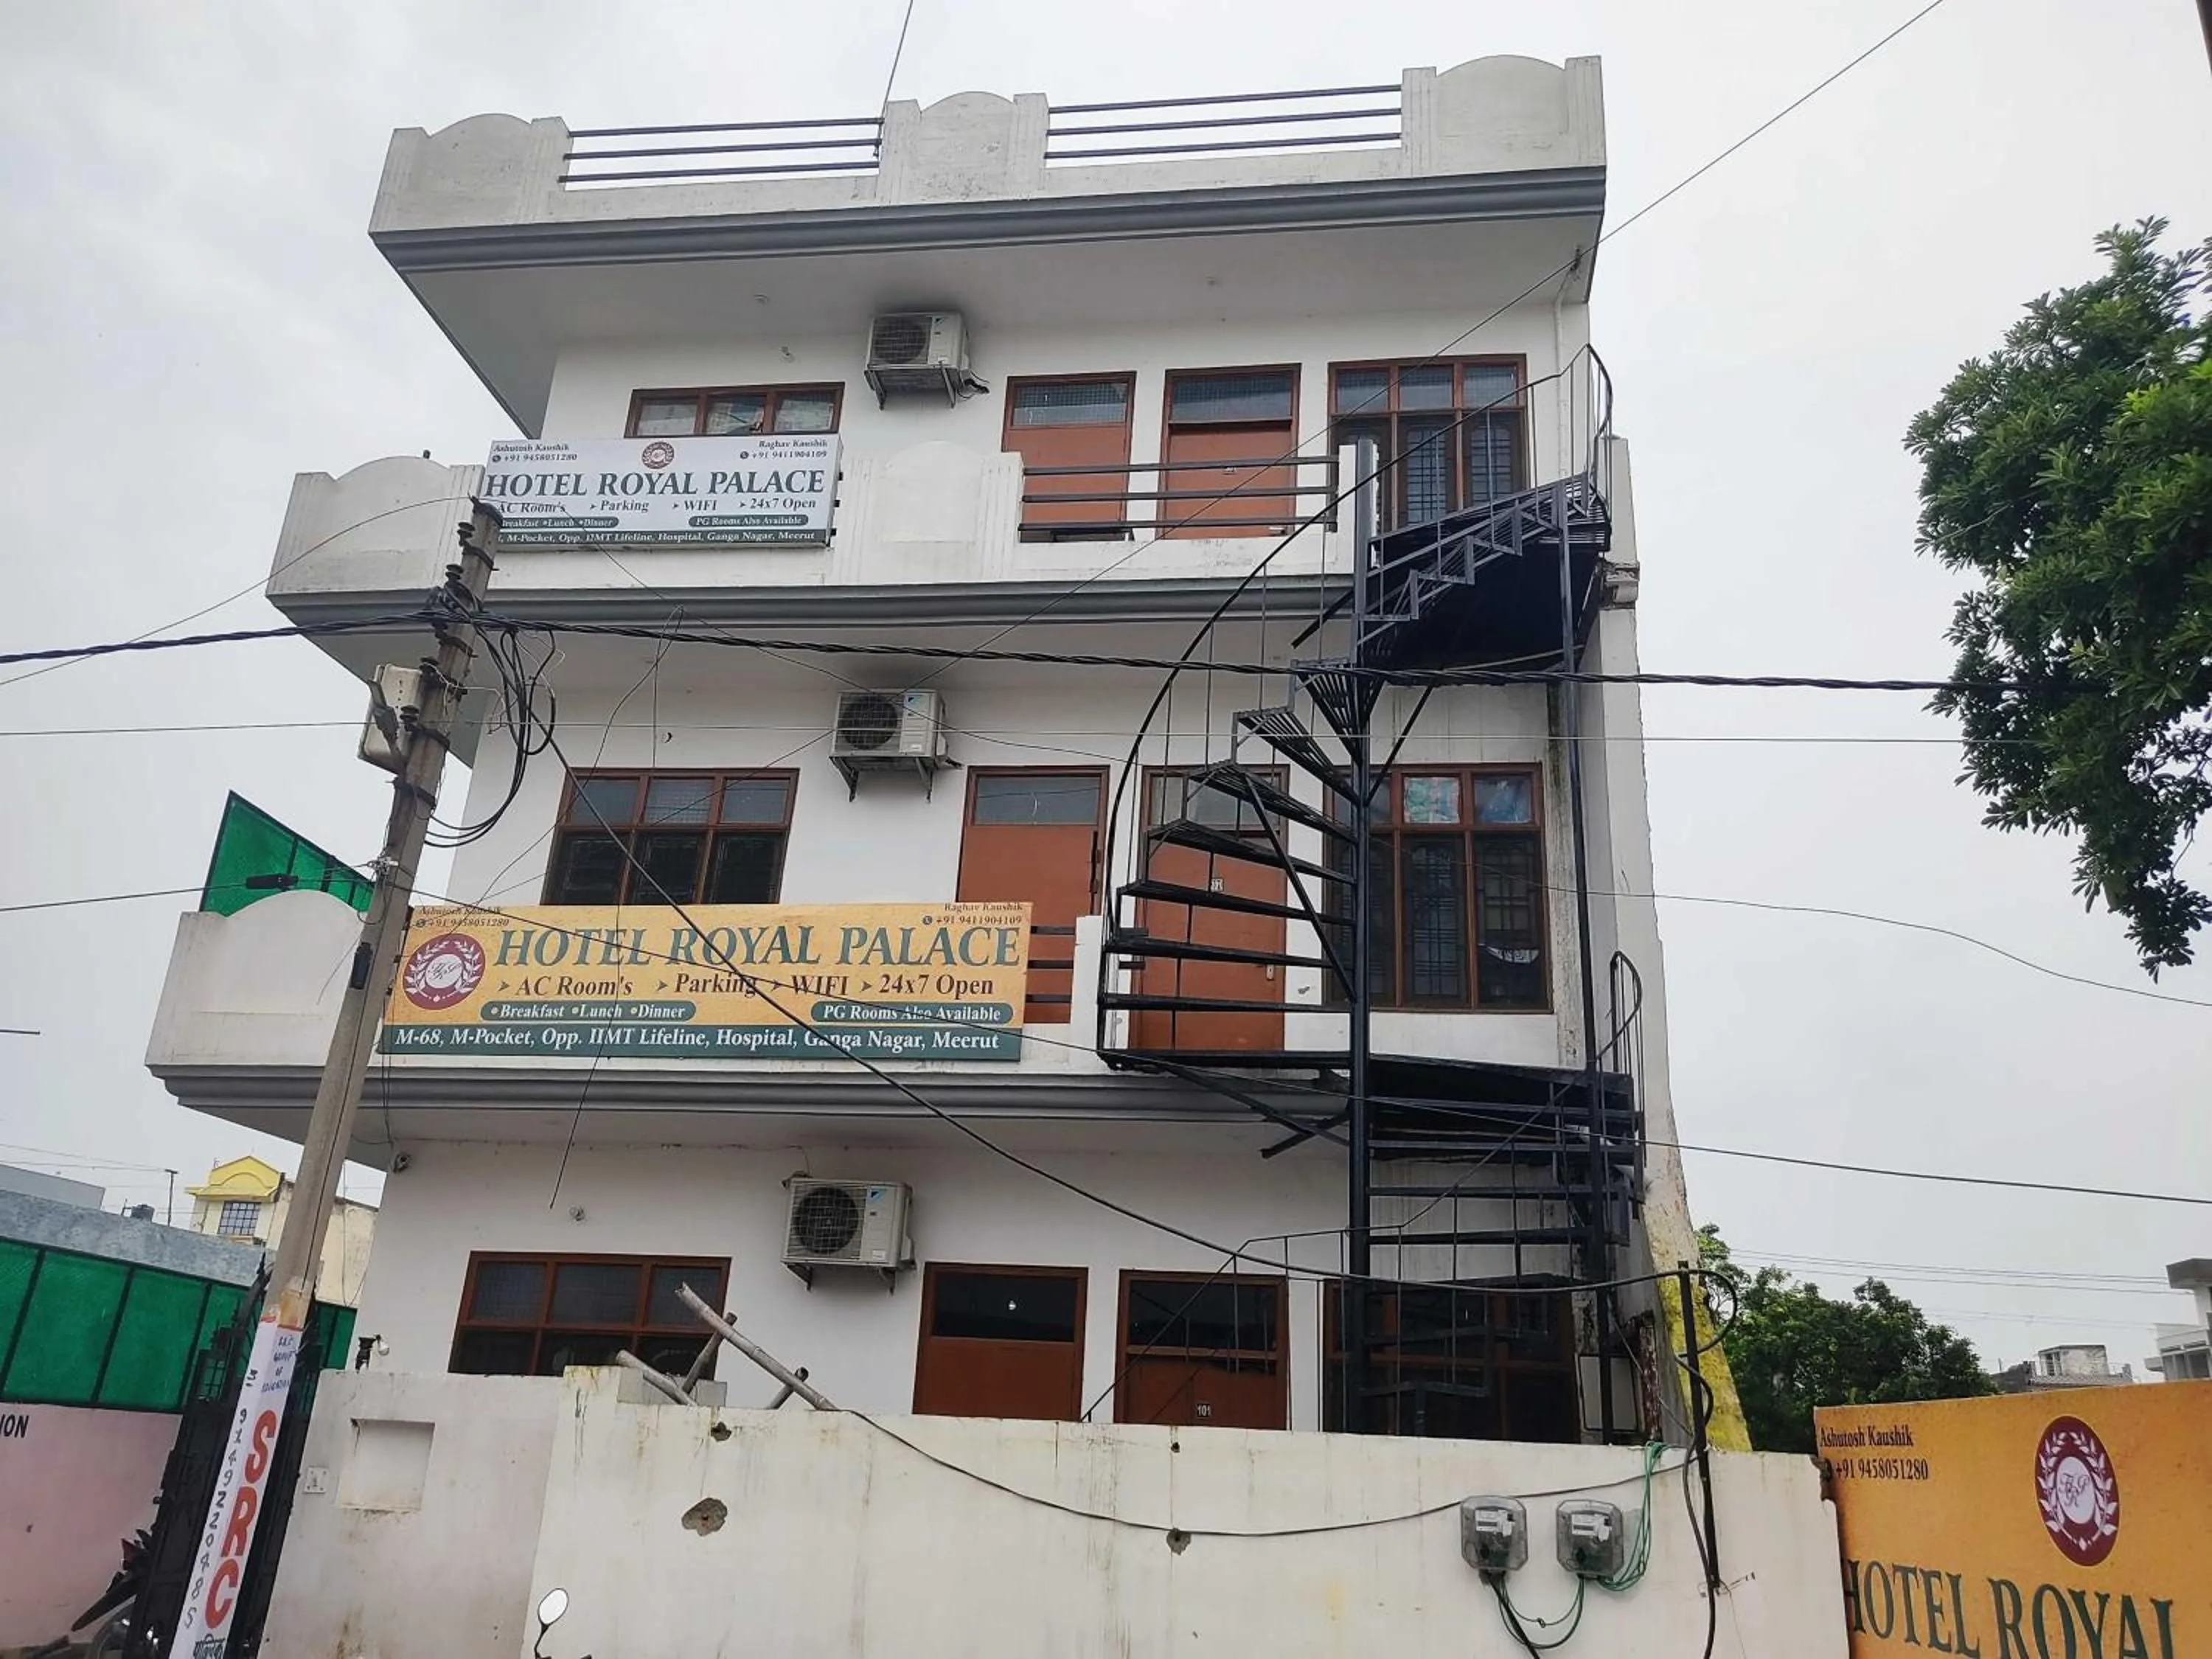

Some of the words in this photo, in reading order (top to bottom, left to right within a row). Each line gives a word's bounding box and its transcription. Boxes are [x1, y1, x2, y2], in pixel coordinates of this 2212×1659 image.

[483, 473, 588, 497] HOTEL
[597, 472, 699, 496] ROYAL
[707, 470, 825, 495] PALACE
[521, 501, 566, 514] Room's
[600, 499, 650, 513] Parking
[684, 500, 717, 511] WIFI
[750, 498, 779, 509] 24x7
[782, 497, 816, 510] Open
[696, 517, 710, 526] PG
[712, 517, 742, 526] Rooms
[742, 516, 761, 525] Also
[763, 515, 802, 525] Available
[658, 532, 704, 543] Hospital,
[707, 532, 739, 543] Ganga
[742, 532, 774, 542] Nagar,
[778, 531, 815, 540] Meerut
[494, 929, 652, 967] HOTEL
[665, 925, 822, 967] ROYAL
[835, 925, 1020, 967] PALACE
[515, 975, 552, 996] AC
[557, 975, 633, 996] Room's
[675, 972, 758, 998] Parking
[791, 975, 849, 996] WIFI
[879, 974, 929, 995] 24x7
[936, 975, 993, 1000] Open
[500, 1004, 566, 1018] Breakfast
[580, 1004, 622, 1018] Lunch
[638, 1004, 685, 1018] Dinner
[823, 1005, 846, 1020] PG
[850, 1005, 897, 1020] Rooms
[902, 1004, 931, 1020] Also
[936, 1004, 1001, 1021] Available
[394, 1028, 444, 1046] M-68,
[449, 1028, 535, 1047] M-Pocket,
[542, 1028, 582, 1052] Opp.
[590, 1028, 639, 1046] IIMT
[639, 1027, 709, 1048] Lifeline,
[716, 1029, 797, 1051] Hospital,
[805, 1029, 861, 1051] Ganga
[868, 1029, 926, 1053] Nagar,
[932, 1032, 998, 1048] Meerut
[1197, 1404, 1211, 1416] 101
[1820, 1426, 1865, 1447] Ashutosh
[1867, 1423, 1914, 1447] Kaushik
[1836, 1458, 1855, 1479] +91
[1858, 1458, 1929, 1481] 9458051280
[205, 1410, 277, 1629] SRC
[1844, 1558, 1980, 1658] HOTEL
